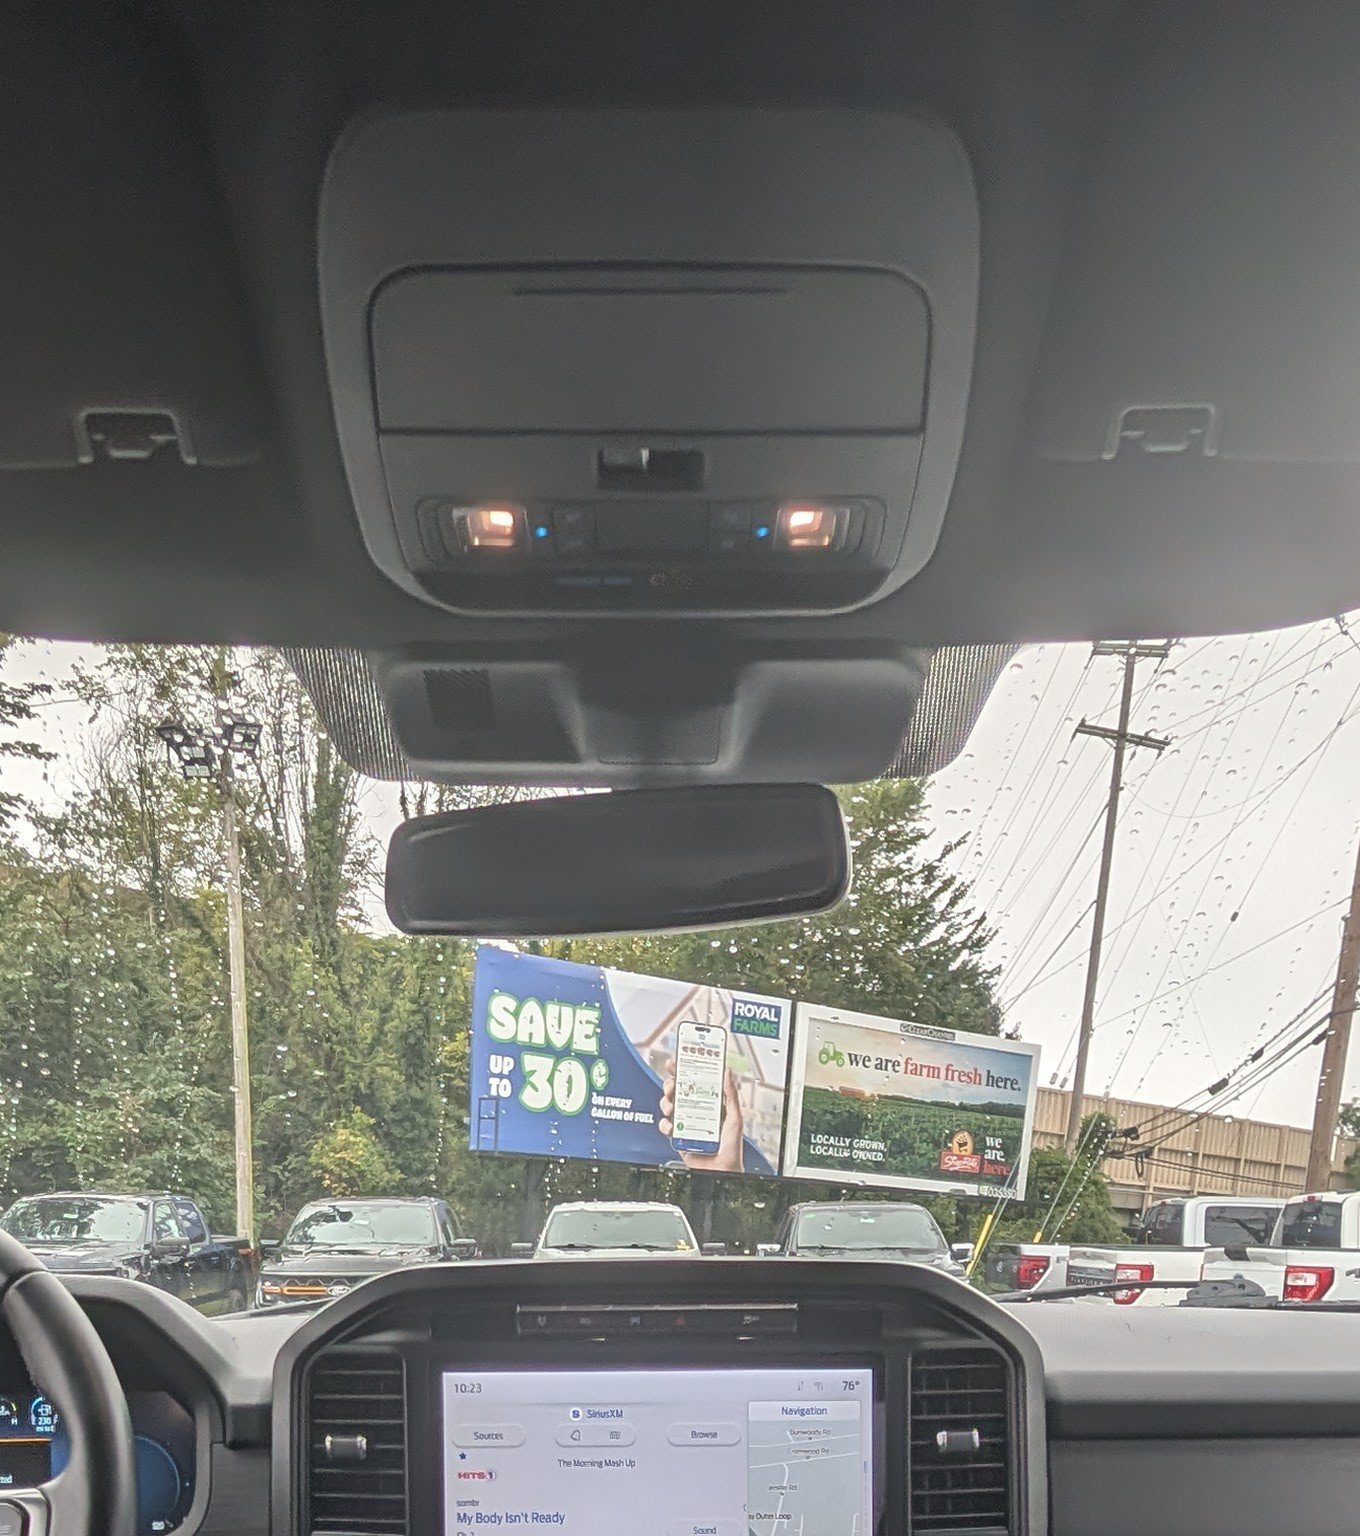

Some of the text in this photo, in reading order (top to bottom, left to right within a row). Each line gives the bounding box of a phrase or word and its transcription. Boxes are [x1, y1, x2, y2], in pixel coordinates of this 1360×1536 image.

[734, 1002, 779, 1022] ROYAL
[488, 993, 600, 1055] SAVE
[734, 1019, 778, 1036] FARMS
[489, 1054, 515, 1075] UP
[847, 1052, 1022, 1092] we are farm fresh here.
[489, 1077, 512, 1098] TO
[604, 1096, 632, 1108] EVERY
[591, 1106, 654, 1124] GALLON OF FUEL
[811, 1133, 852, 1148] LOCALLY
[985, 1136, 1003, 1148] we
[454, 1383, 482, 1394] 10:23
[587, 1409, 624, 1420] SiriusXM
[781, 1406, 828, 1418] Navigation
[473, 1431, 504, 1441] Sources
[691, 1430, 719, 1440] Browse
[557, 1459, 636, 1469] The Morning Mash Up
[456, 1511, 566, 1525] My Body Isn't Ready
[775, 1513, 793, 1521] Loop
[693, 1526, 718, 1535] Sound
